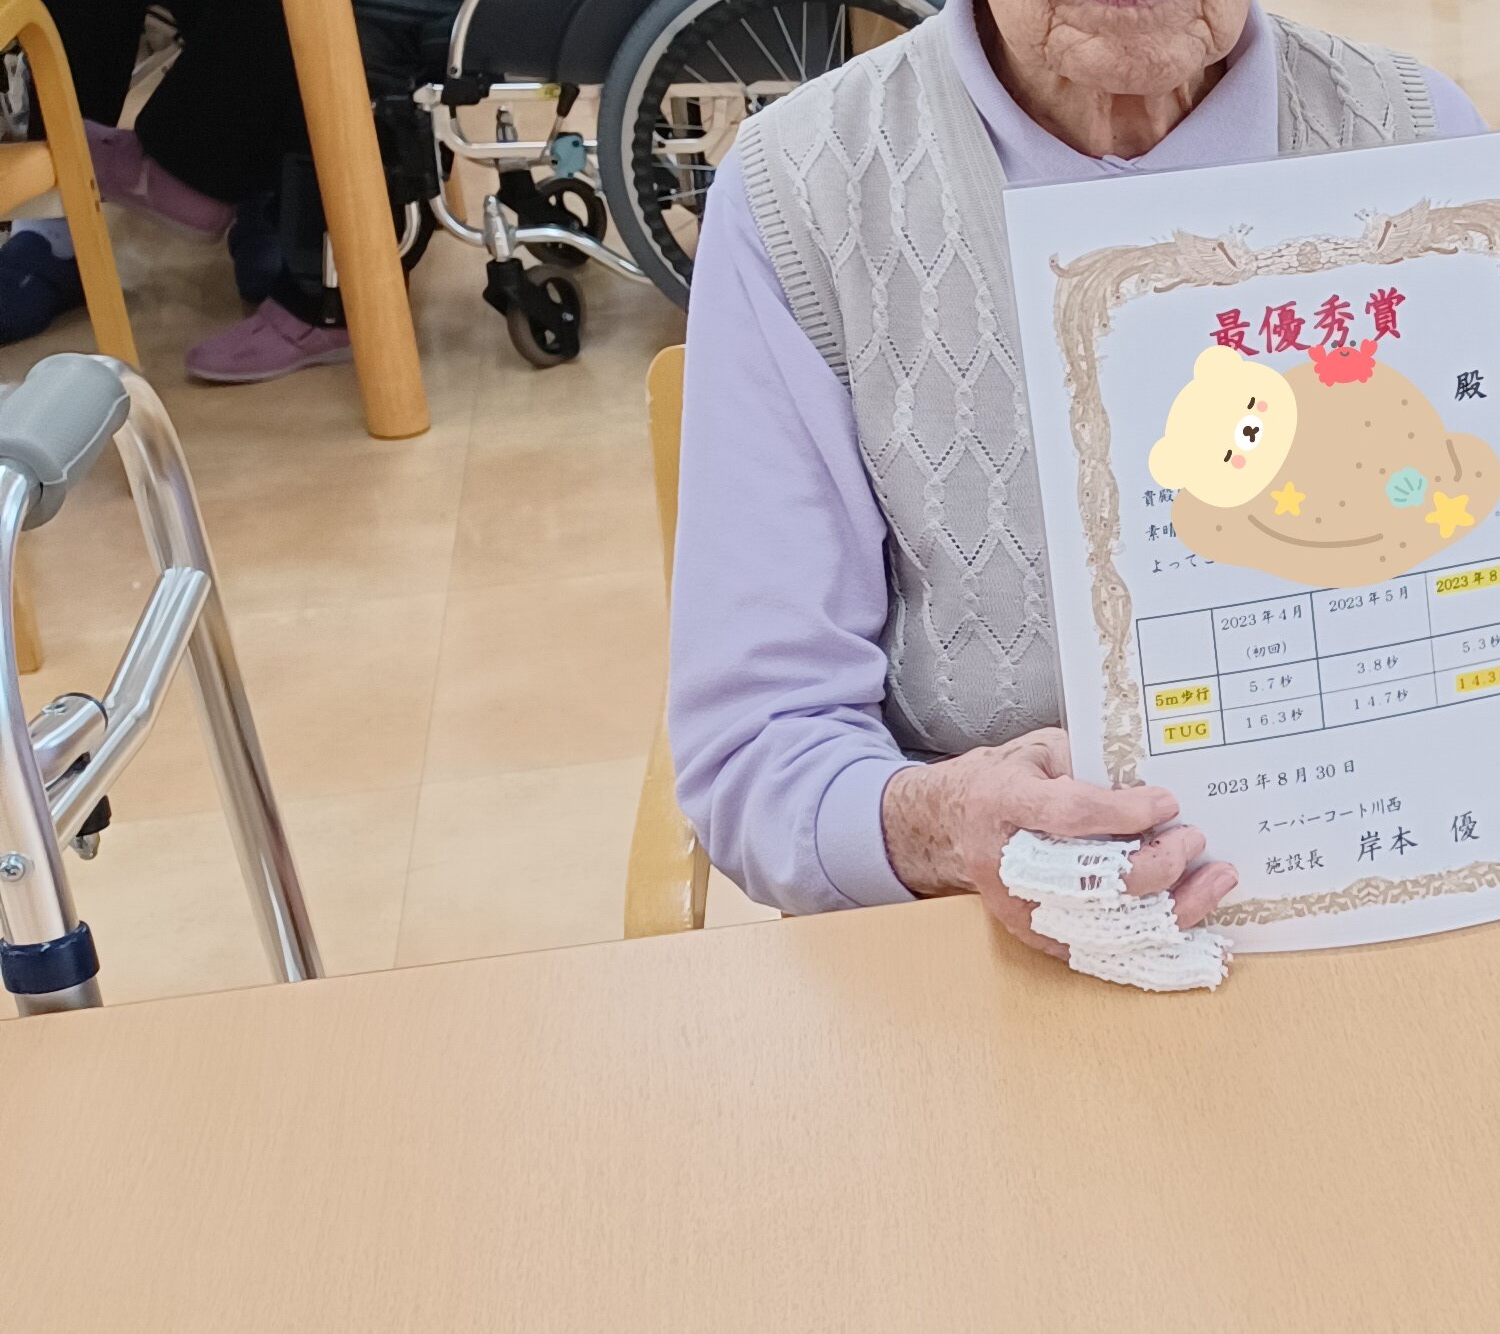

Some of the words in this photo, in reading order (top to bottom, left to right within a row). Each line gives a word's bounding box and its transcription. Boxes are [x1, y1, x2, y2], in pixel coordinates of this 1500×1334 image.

[1210, 287, 1406, 356] 最優秀賞
[1455, 369, 1488, 401] 殿
[1152, 553, 1215, 573] よって
[1165, 723, 1208, 740] TUG
[1258, 796, 1402, 834] スーパーコート川西
[1266, 849, 1325, 875] 施設長
[1357, 826, 1419, 862] 岸本
[1451, 810, 1481, 843] 優
